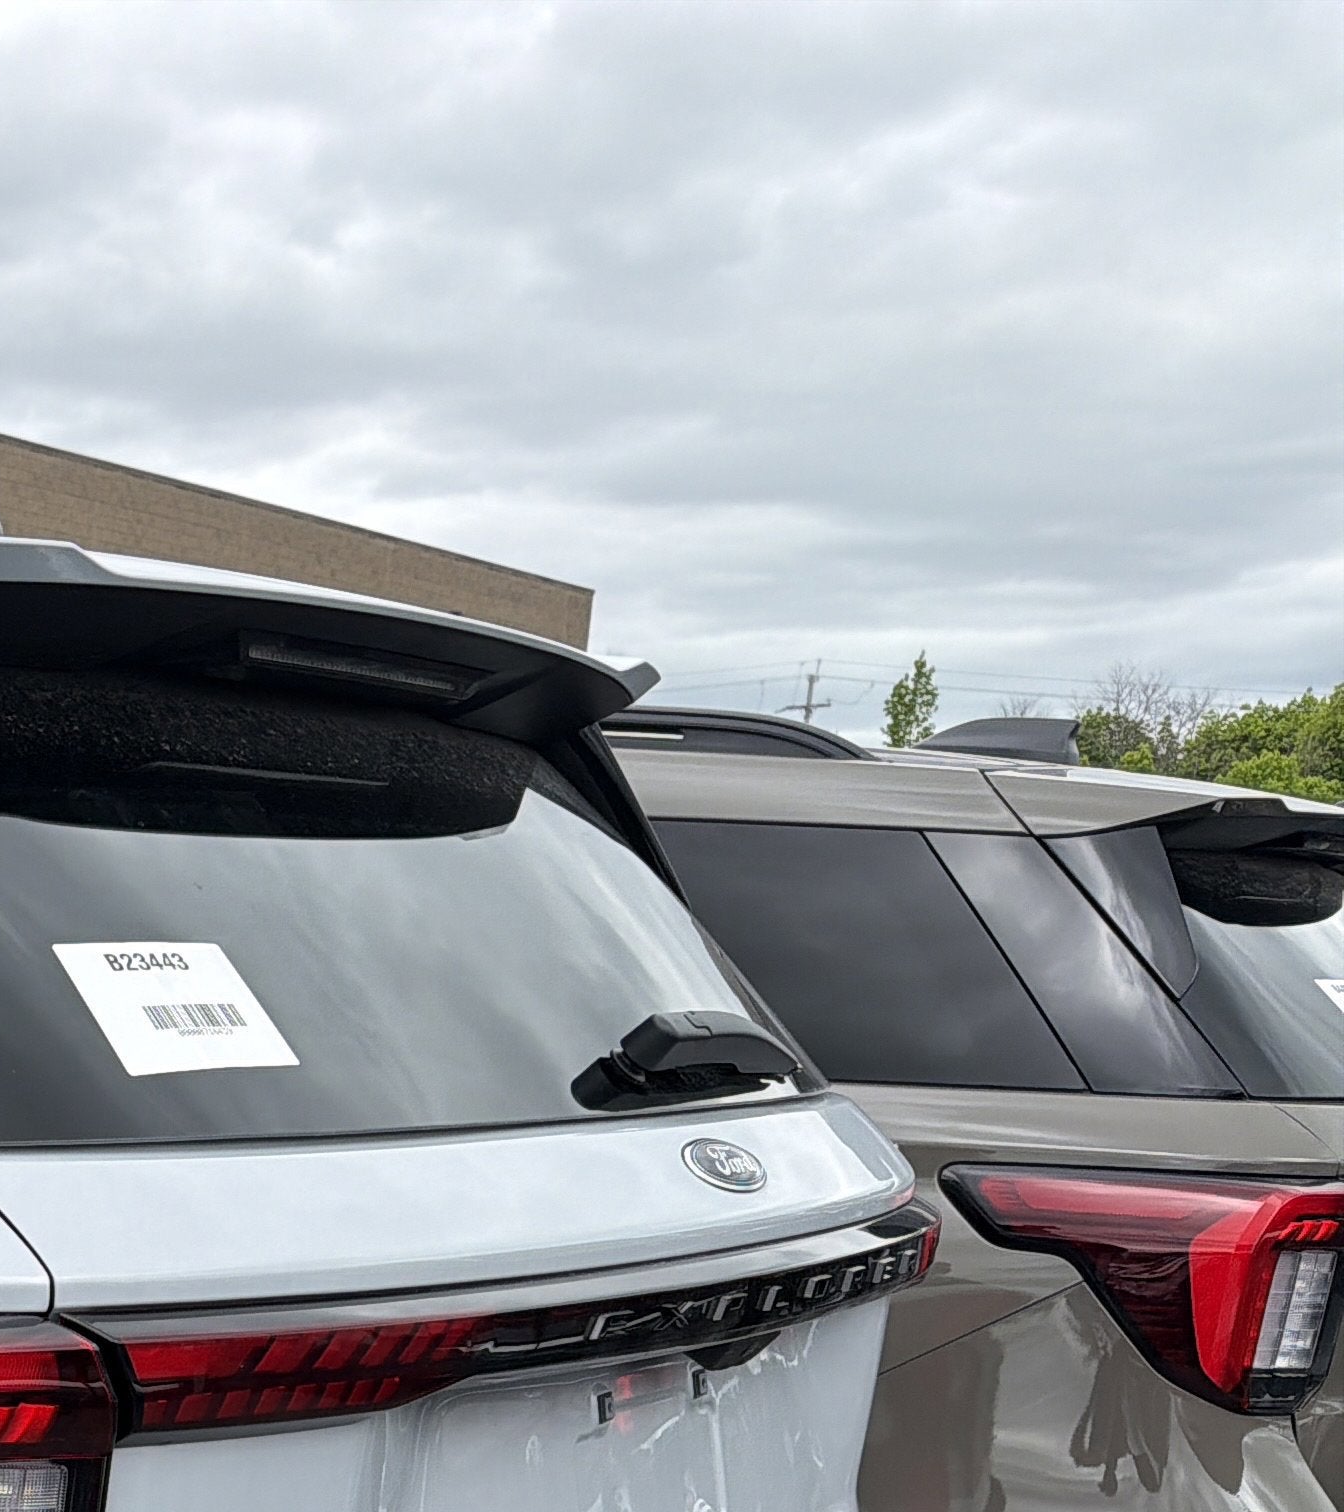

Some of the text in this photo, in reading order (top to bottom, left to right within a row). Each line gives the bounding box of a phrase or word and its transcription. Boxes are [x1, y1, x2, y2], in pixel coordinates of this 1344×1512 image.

[102, 952, 190, 972] B23443
[705, 1144, 762, 1177] Ford
[585, 1248, 920, 1342] EXPLORER
